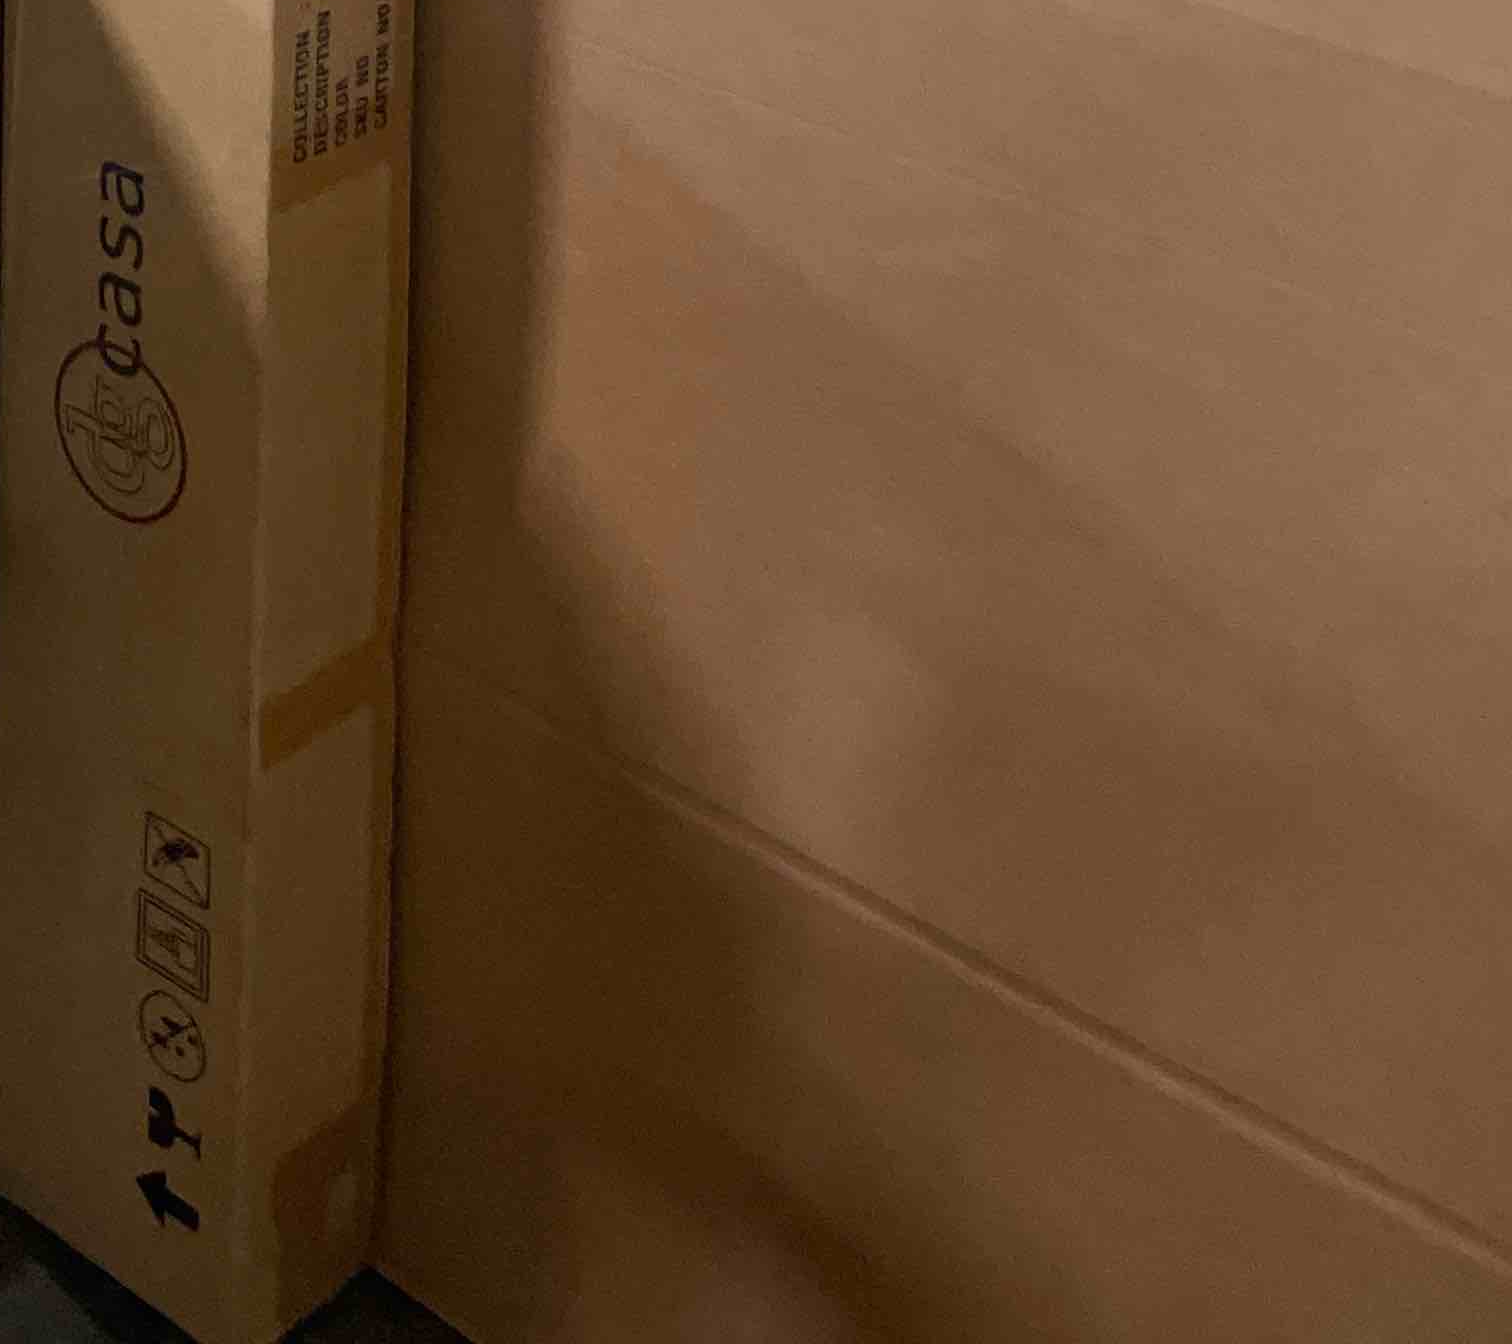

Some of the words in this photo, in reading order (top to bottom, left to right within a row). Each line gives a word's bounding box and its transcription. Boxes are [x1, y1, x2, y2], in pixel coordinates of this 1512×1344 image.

[293, 30, 312, 163] COLLECTION
[313, 9, 331, 157] DESCRIPTION
[334, 76, 350, 148] COLOR
[353, 95, 368, 139] SKU
[373, 45, 390, 130] CARTON
[98, 160, 146, 377] casa
